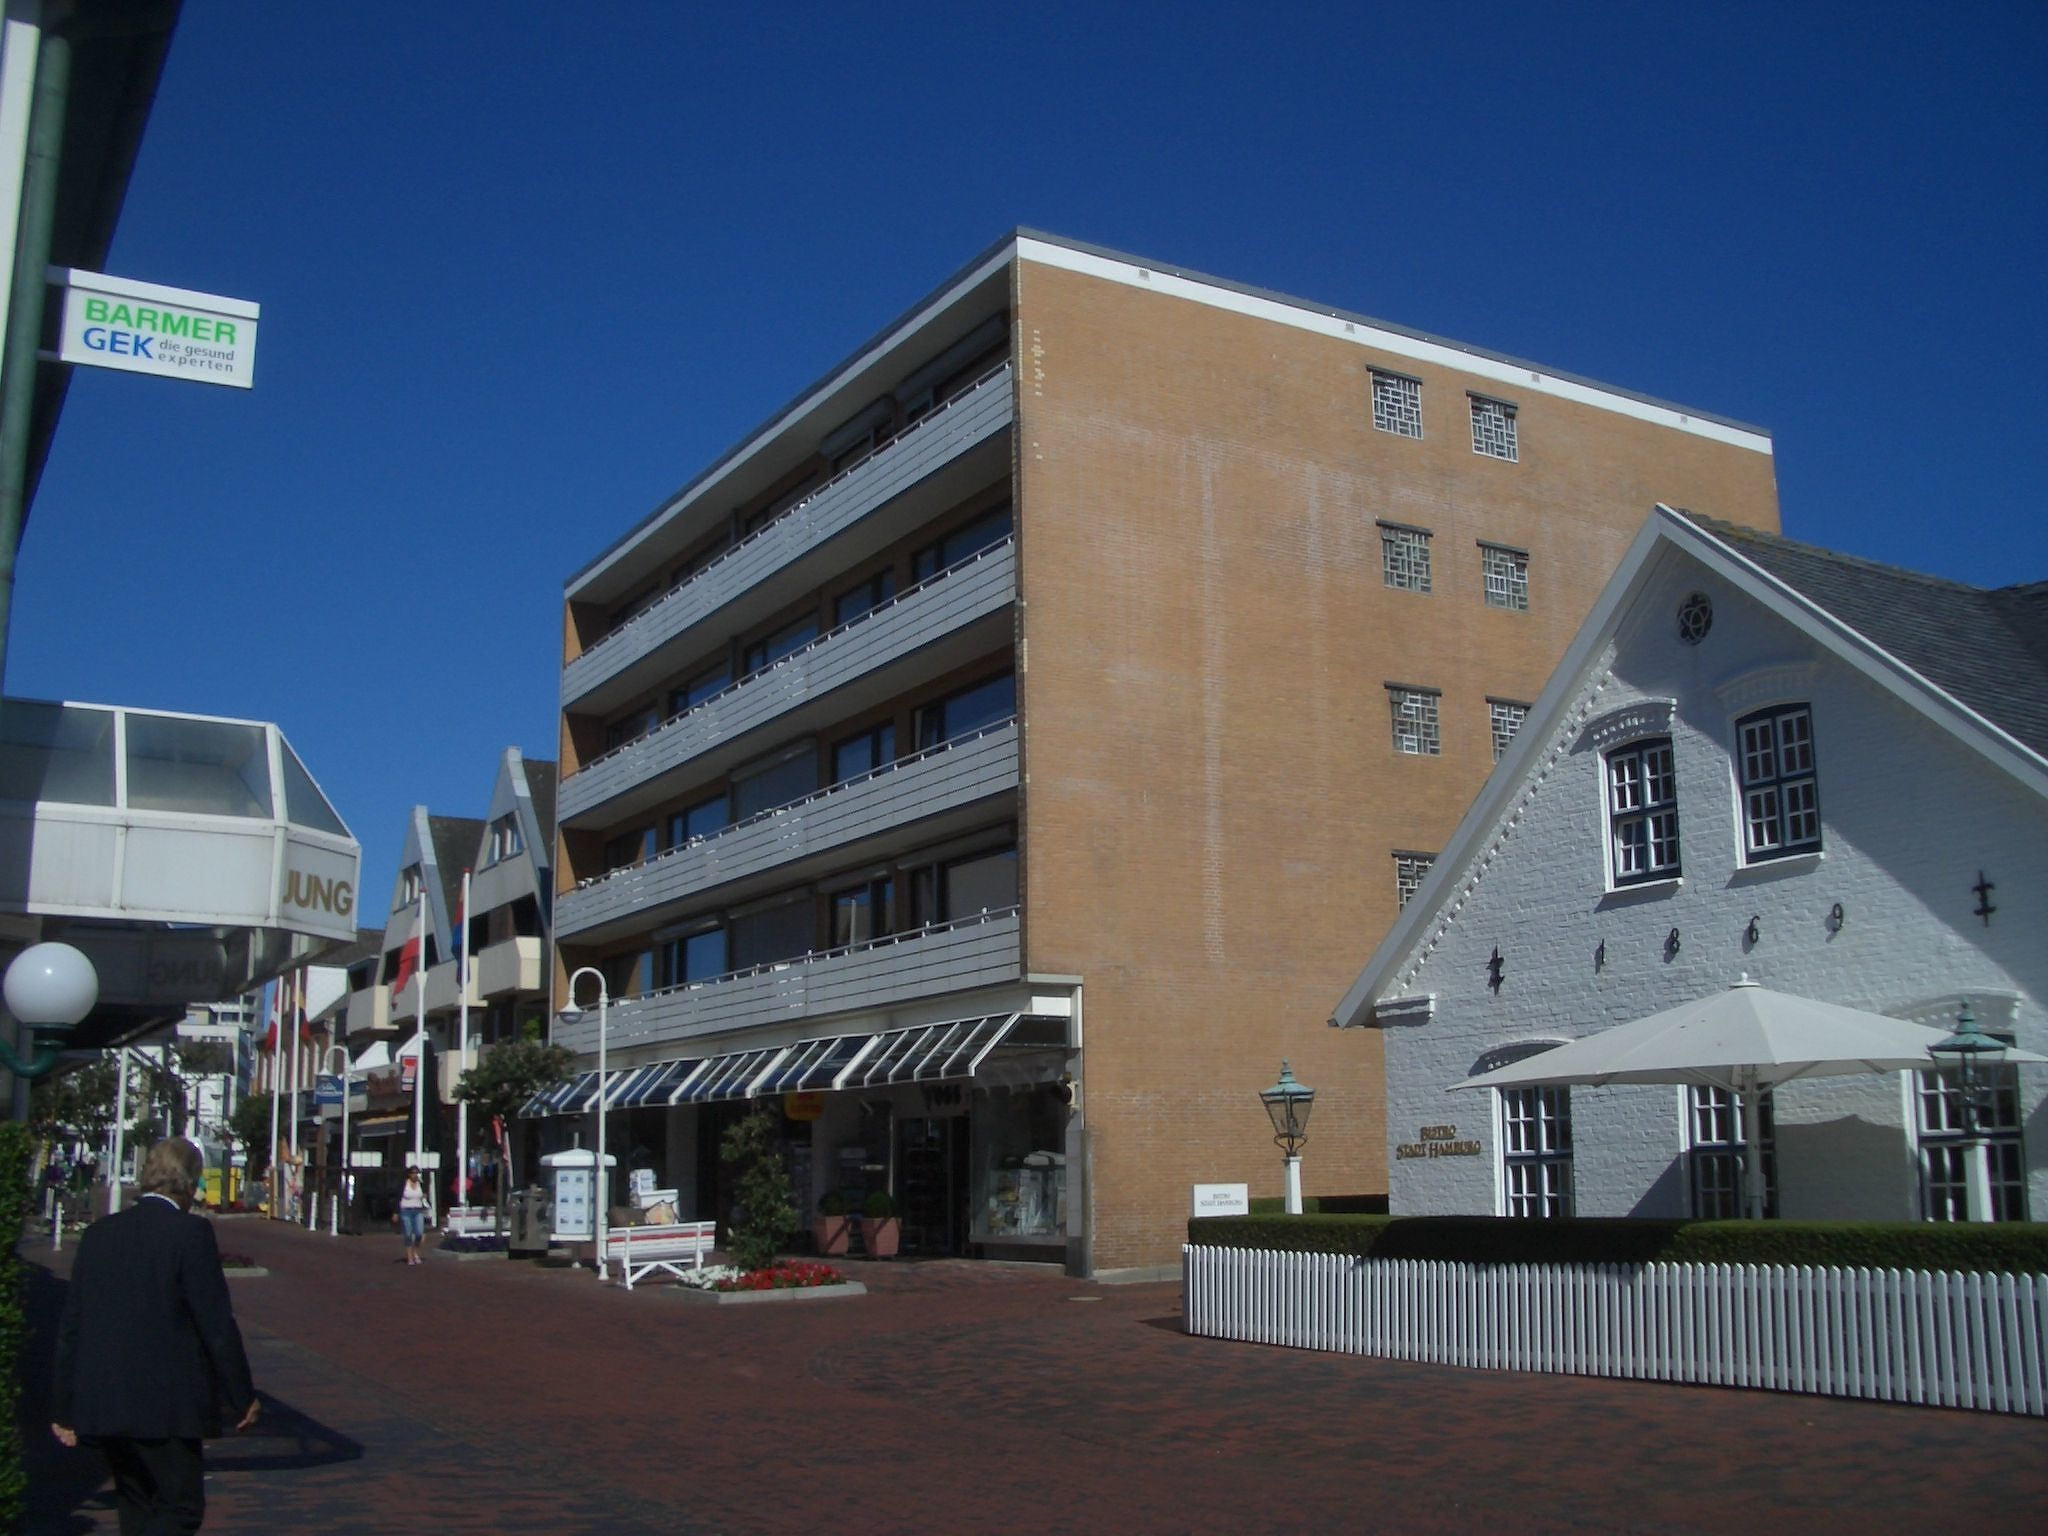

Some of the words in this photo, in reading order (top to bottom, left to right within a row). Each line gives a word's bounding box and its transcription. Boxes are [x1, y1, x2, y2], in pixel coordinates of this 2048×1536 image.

[85, 298, 237, 345] BARMER
[83, 327, 154, 359] GEK
[159, 339, 181, 352] die
[185, 345, 235, 361] gesund
[158, 352, 233, 373] experten
[282, 869, 354, 916] JUNG
